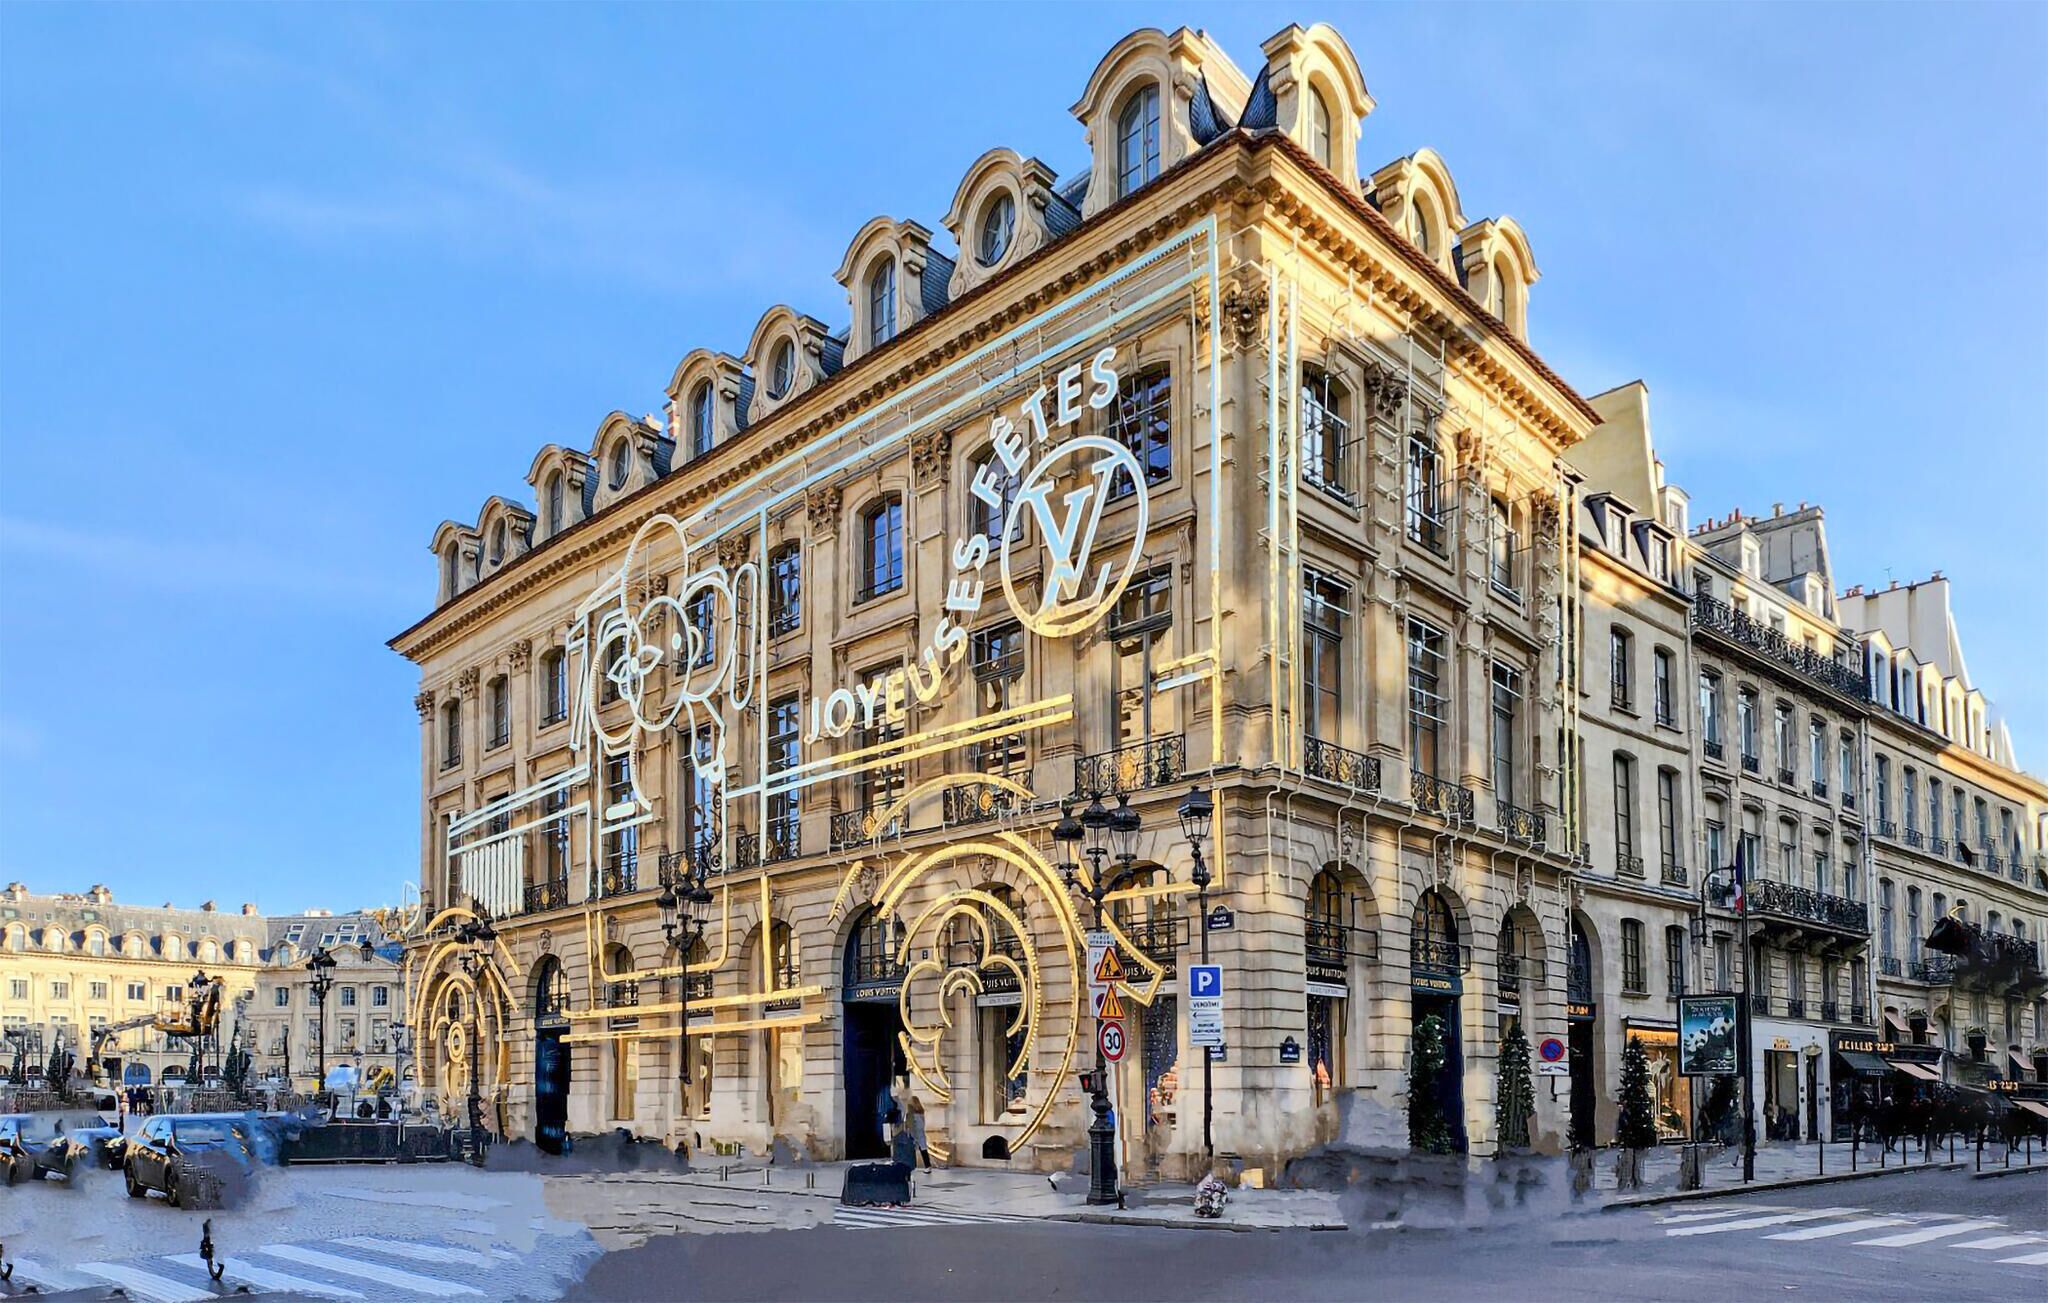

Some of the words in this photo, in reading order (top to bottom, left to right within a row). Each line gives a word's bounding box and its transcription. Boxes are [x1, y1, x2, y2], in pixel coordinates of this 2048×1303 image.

[803, 533, 990, 745] JOYEUSES
[970, 347, 1119, 510] FÊTES
[1198, 971, 1213, 992] P
[1105, 1032, 1121, 1050] 30
